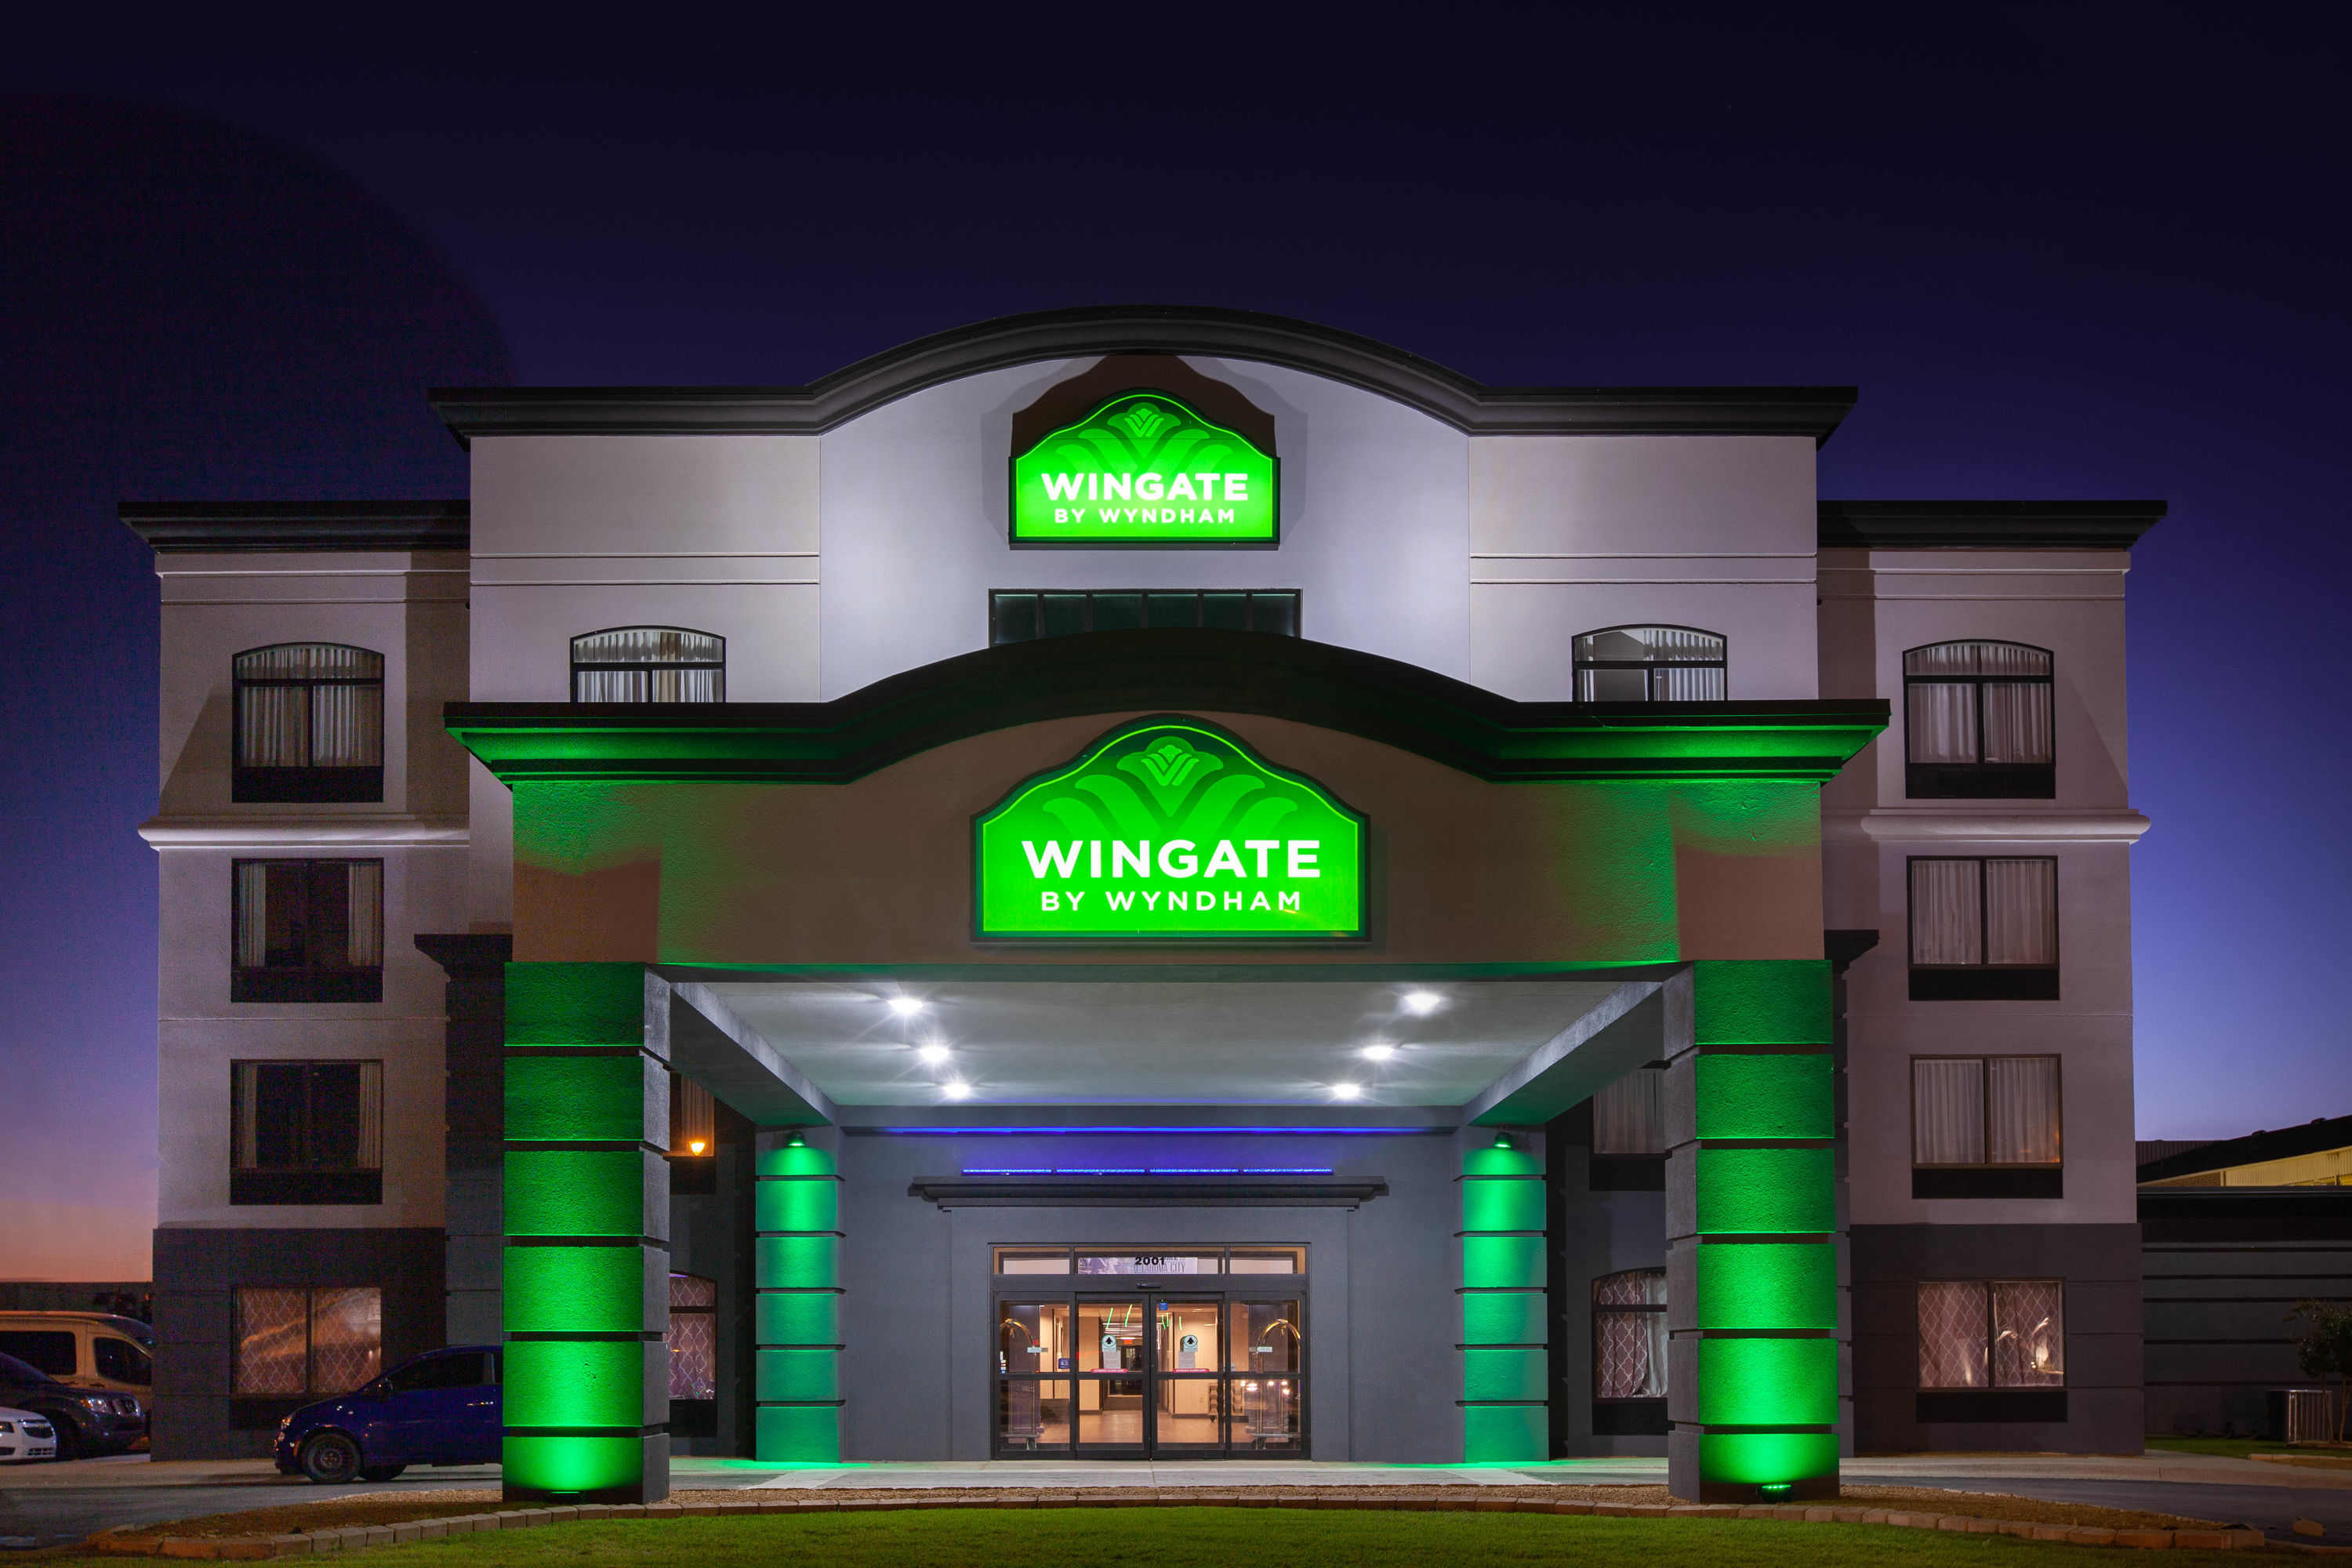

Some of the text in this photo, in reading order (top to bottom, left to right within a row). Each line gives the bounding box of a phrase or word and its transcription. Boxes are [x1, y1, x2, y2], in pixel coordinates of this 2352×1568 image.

[1041, 473, 1248, 501] WINGATE
[1054, 508, 1235, 524] BY WYNDHAM
[1022, 839, 1320, 878] WINGATE
[1041, 891, 1301, 911] BY WYNDHAM
[1134, 1257, 1165, 1265] 2001
[1171, 1262, 1185, 1272] CITY
